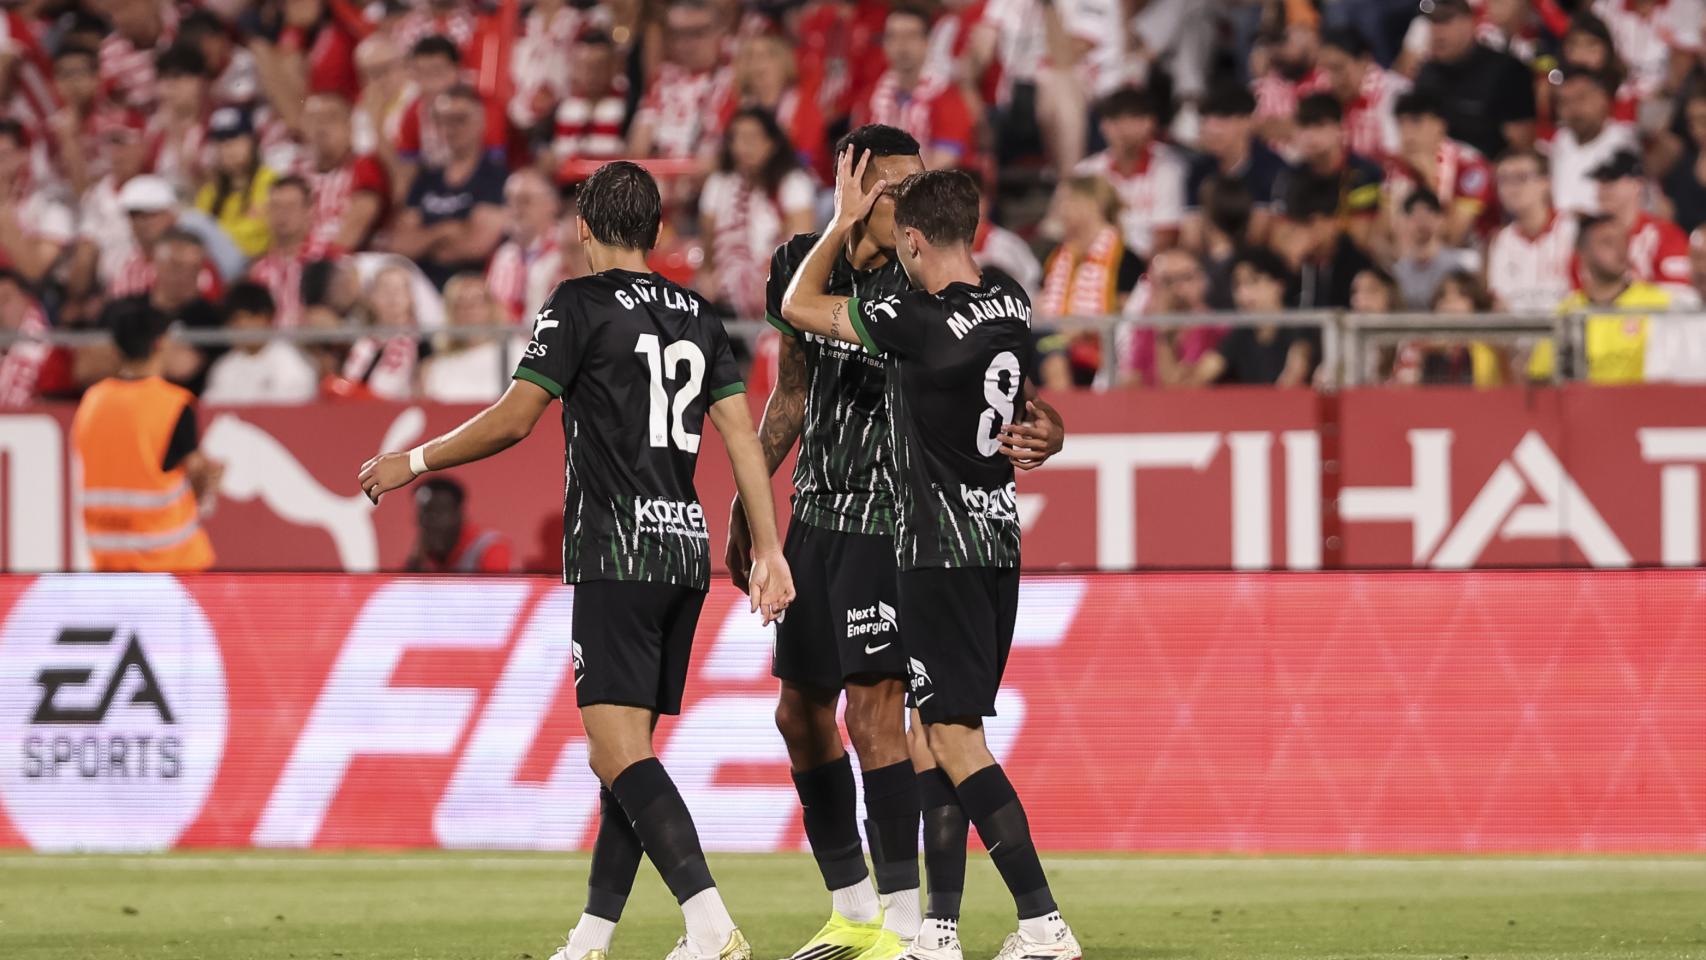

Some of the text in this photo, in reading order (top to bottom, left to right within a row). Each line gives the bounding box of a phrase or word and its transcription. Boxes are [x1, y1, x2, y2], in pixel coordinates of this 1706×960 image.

[862, 356, 884, 369] FIBRA
[634, 333, 706, 454] 12
[976, 351, 1021, 457] 8
[847, 605, 877, 623] Next
[847, 618, 891, 638] Energía
[32, 627, 175, 725] EA
[24, 736, 180, 779] SPORTS
